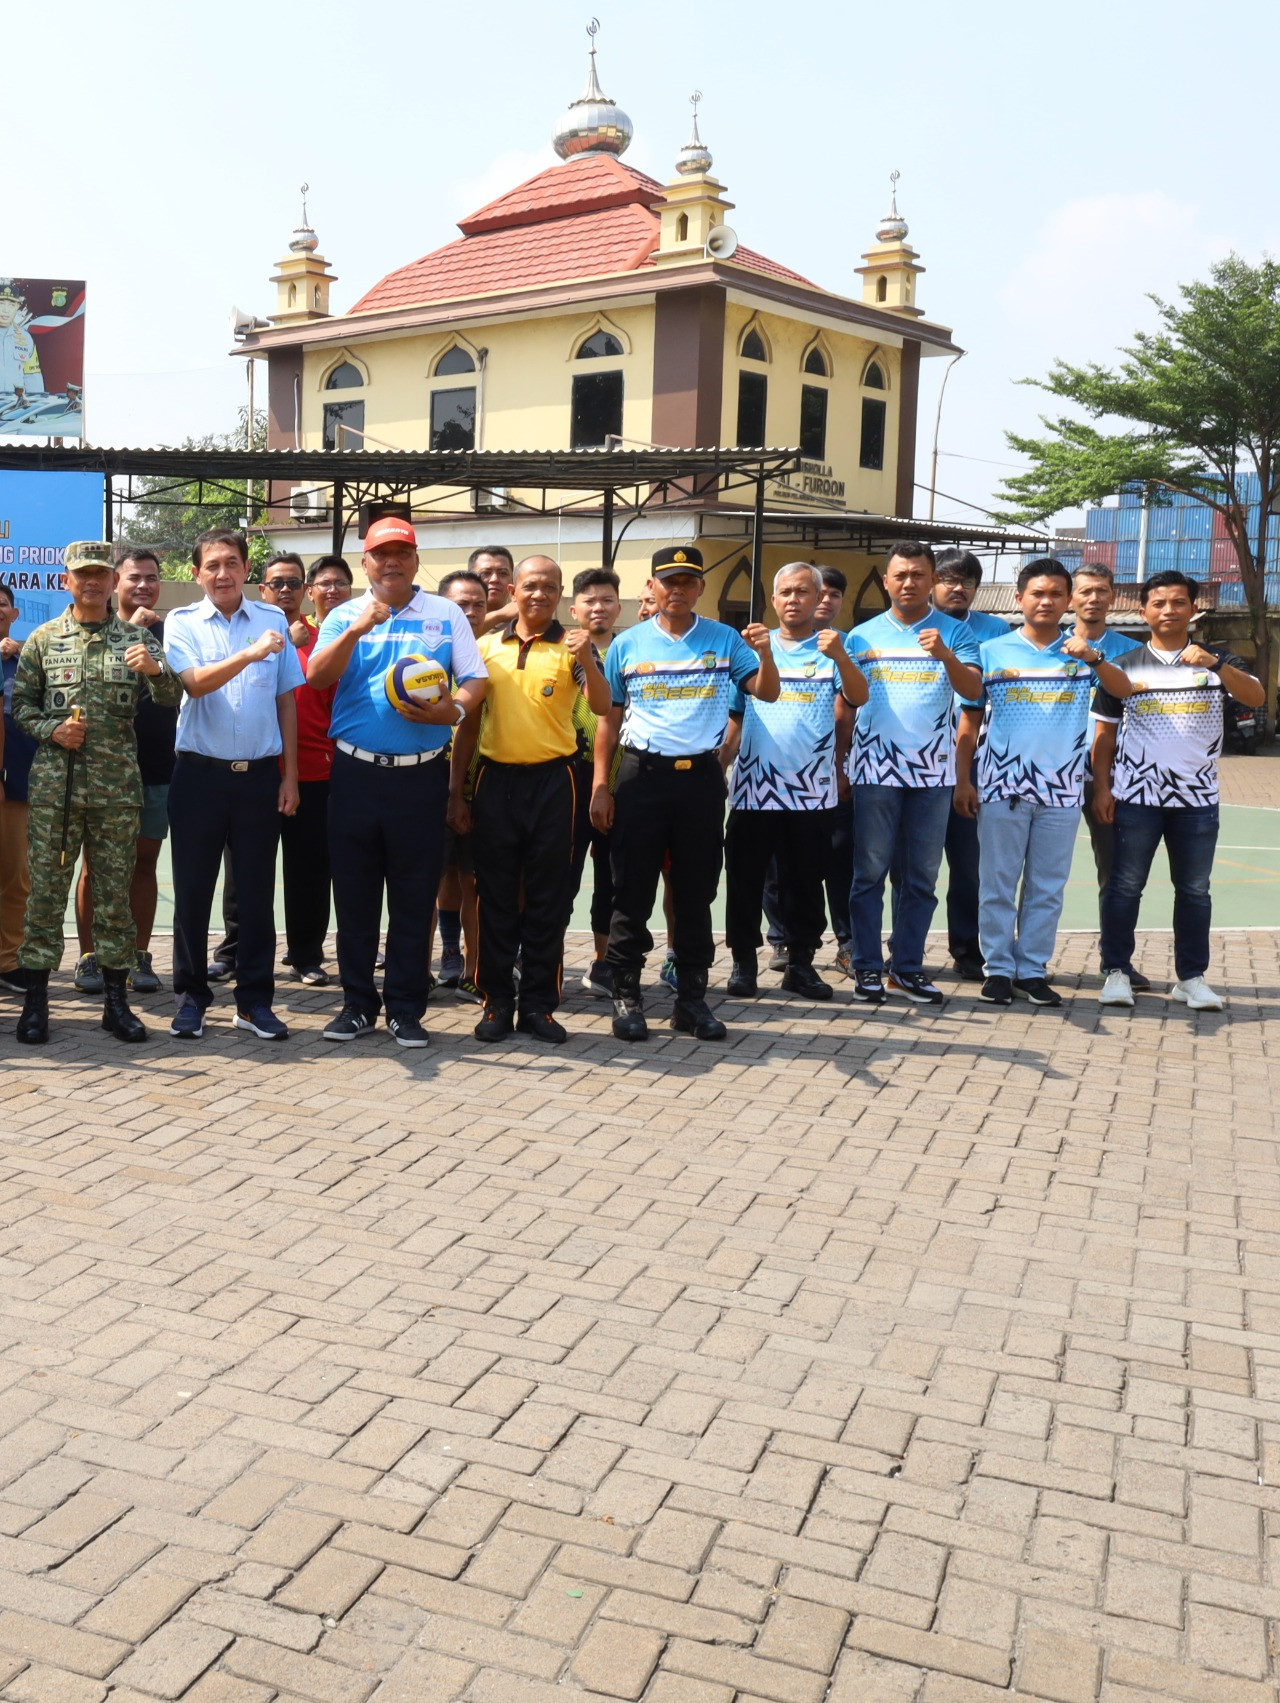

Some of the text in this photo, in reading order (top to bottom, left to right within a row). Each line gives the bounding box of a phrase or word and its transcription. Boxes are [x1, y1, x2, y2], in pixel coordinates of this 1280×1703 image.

[802, 476, 846, 497] FURQON
[18, 546, 67, 566] PRIOK
[44, 656, 79, 666] FANANY
[641, 685, 717, 701] PRESISI
[1004, 691, 1077, 704] PRESISI
[1136, 701, 1210, 718] PRESISI
